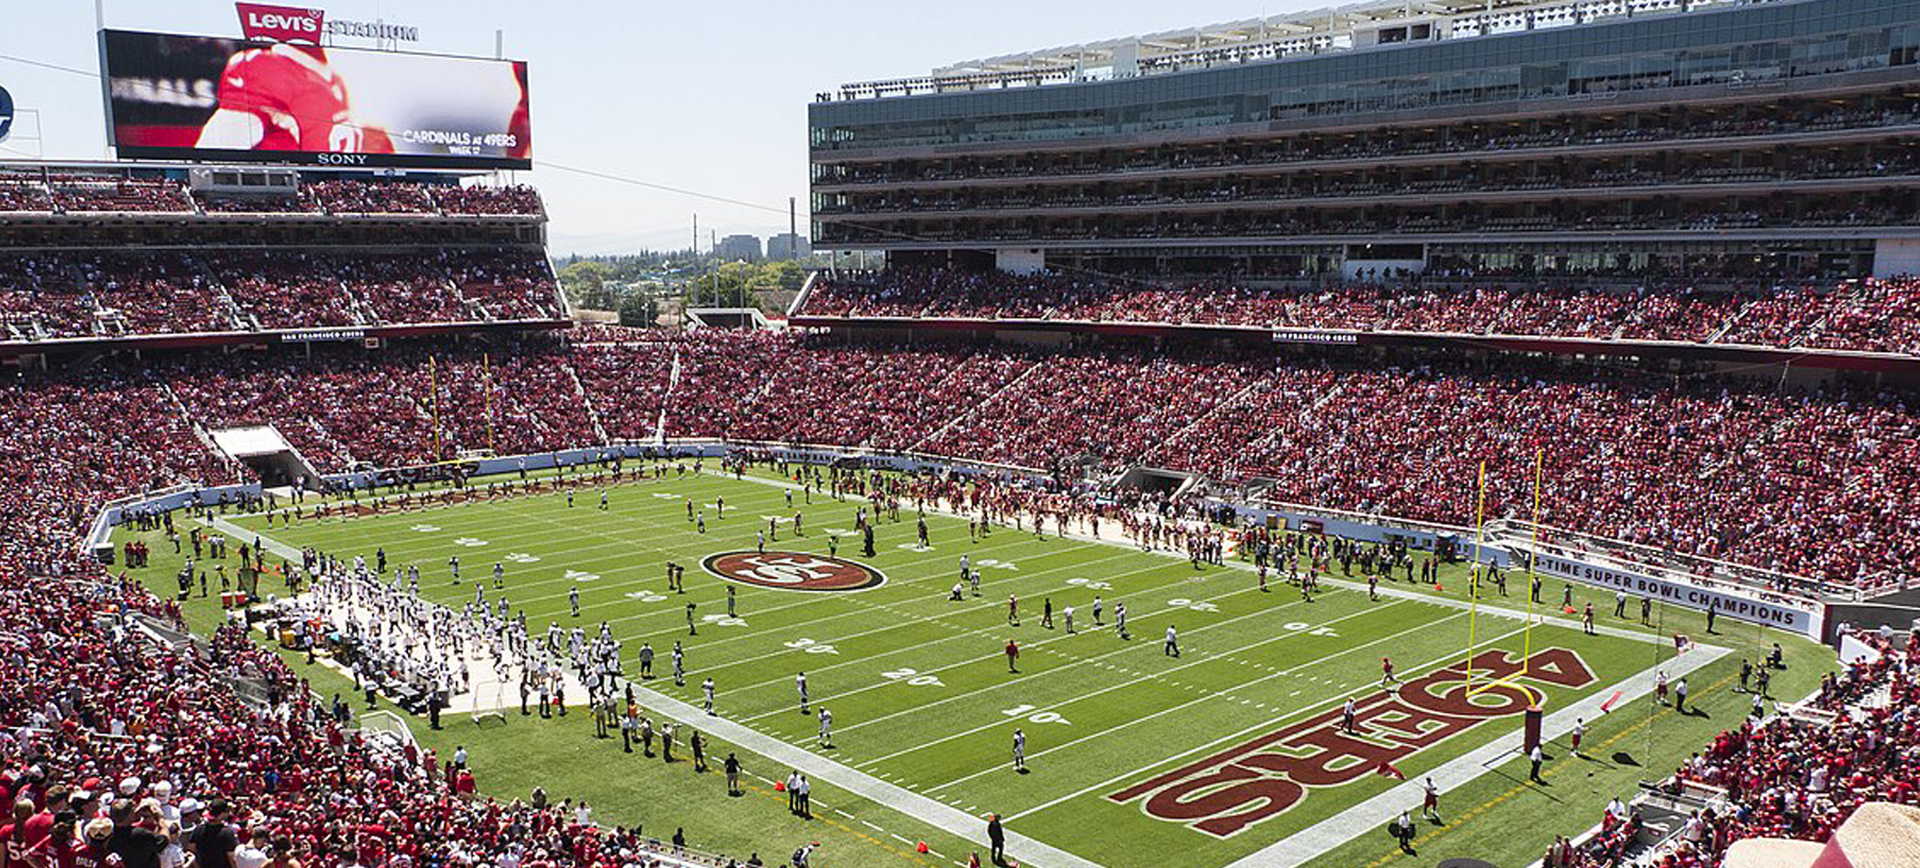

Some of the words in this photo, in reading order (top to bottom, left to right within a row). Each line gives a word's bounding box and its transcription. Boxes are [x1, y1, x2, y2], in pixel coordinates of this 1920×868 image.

[329, 19, 419, 42] STADIUM
[402, 129, 471, 145] CARDINALS
[484, 134, 517, 147] 49ERS
[318, 153, 368, 165] SONY
[1288, 332, 1331, 341] FRANCISCO
[1584, 568, 1632, 588] SUPER
[1638, 580, 1682, 600] BOWL
[1688, 591, 1795, 625] CHAMPIONS
[1001, 703, 1062, 724] 10
[1102, 647, 1600, 838] 49ERS
